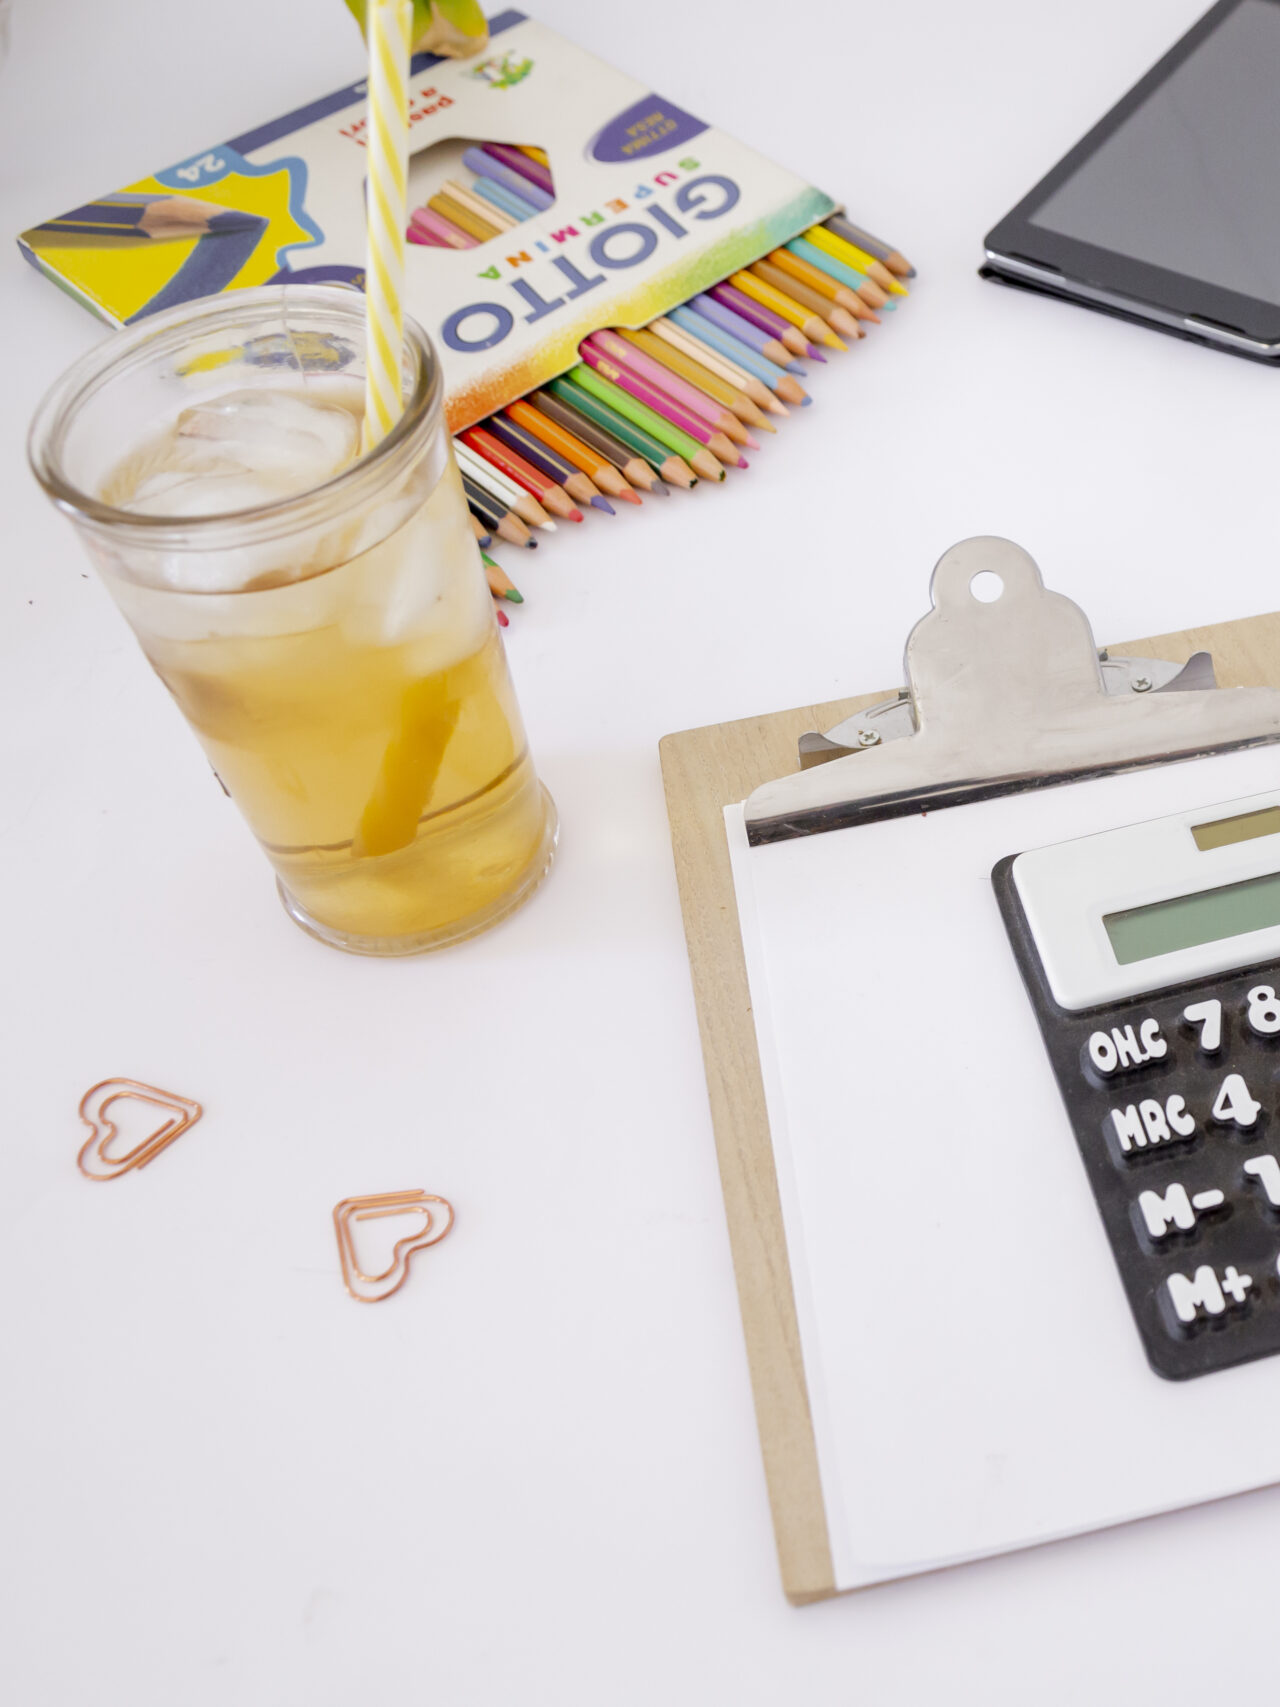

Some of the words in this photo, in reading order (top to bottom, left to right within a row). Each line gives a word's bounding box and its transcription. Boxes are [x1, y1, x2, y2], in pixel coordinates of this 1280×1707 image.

[177, 153, 226, 182] 24
[477, 157, 701, 281] SUPERMINA
[441, 174, 741, 353] GIOTTO
[1184, 999, 1222, 1050] 7
[1110, 1094, 1196, 1152] MRC
[1212, 1073, 1262, 1126] 4
